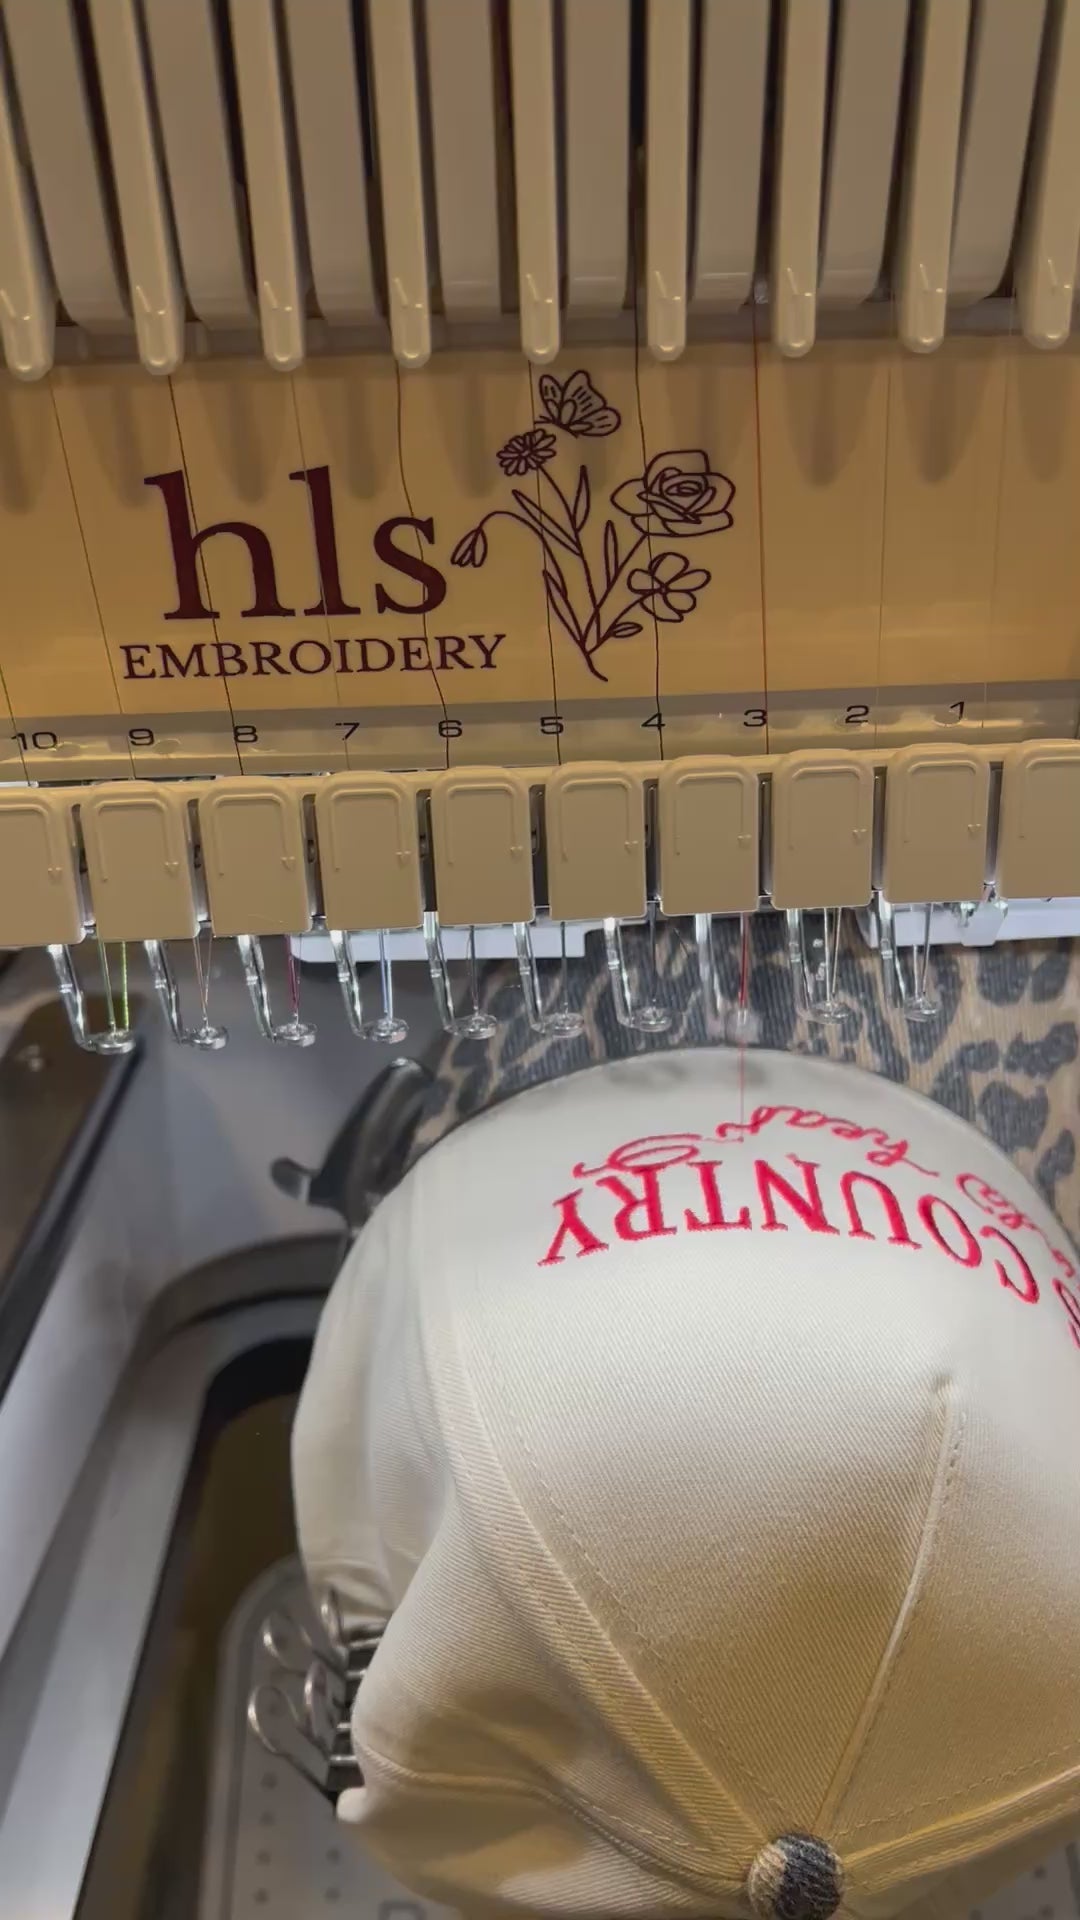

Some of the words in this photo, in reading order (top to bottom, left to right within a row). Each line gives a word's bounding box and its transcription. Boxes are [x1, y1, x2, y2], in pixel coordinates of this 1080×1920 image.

[143, 465, 448, 620] hls
[119, 634, 507, 680] EMBROIDERY
[11, 732, 58, 751] 10
[128, 728, 156, 747] 9
[233, 725, 259, 744] 8
[334, 721, 361, 741] 7
[437, 720, 464, 738] 6
[540, 717, 565, 735] 5
[641, 712, 666, 731] 4
[742, 709, 768, 728] 3
[845, 705, 870, 724] 2
[949, 701, 966, 720] 1
[537, 1158, 1041, 1304] COUNTRY
